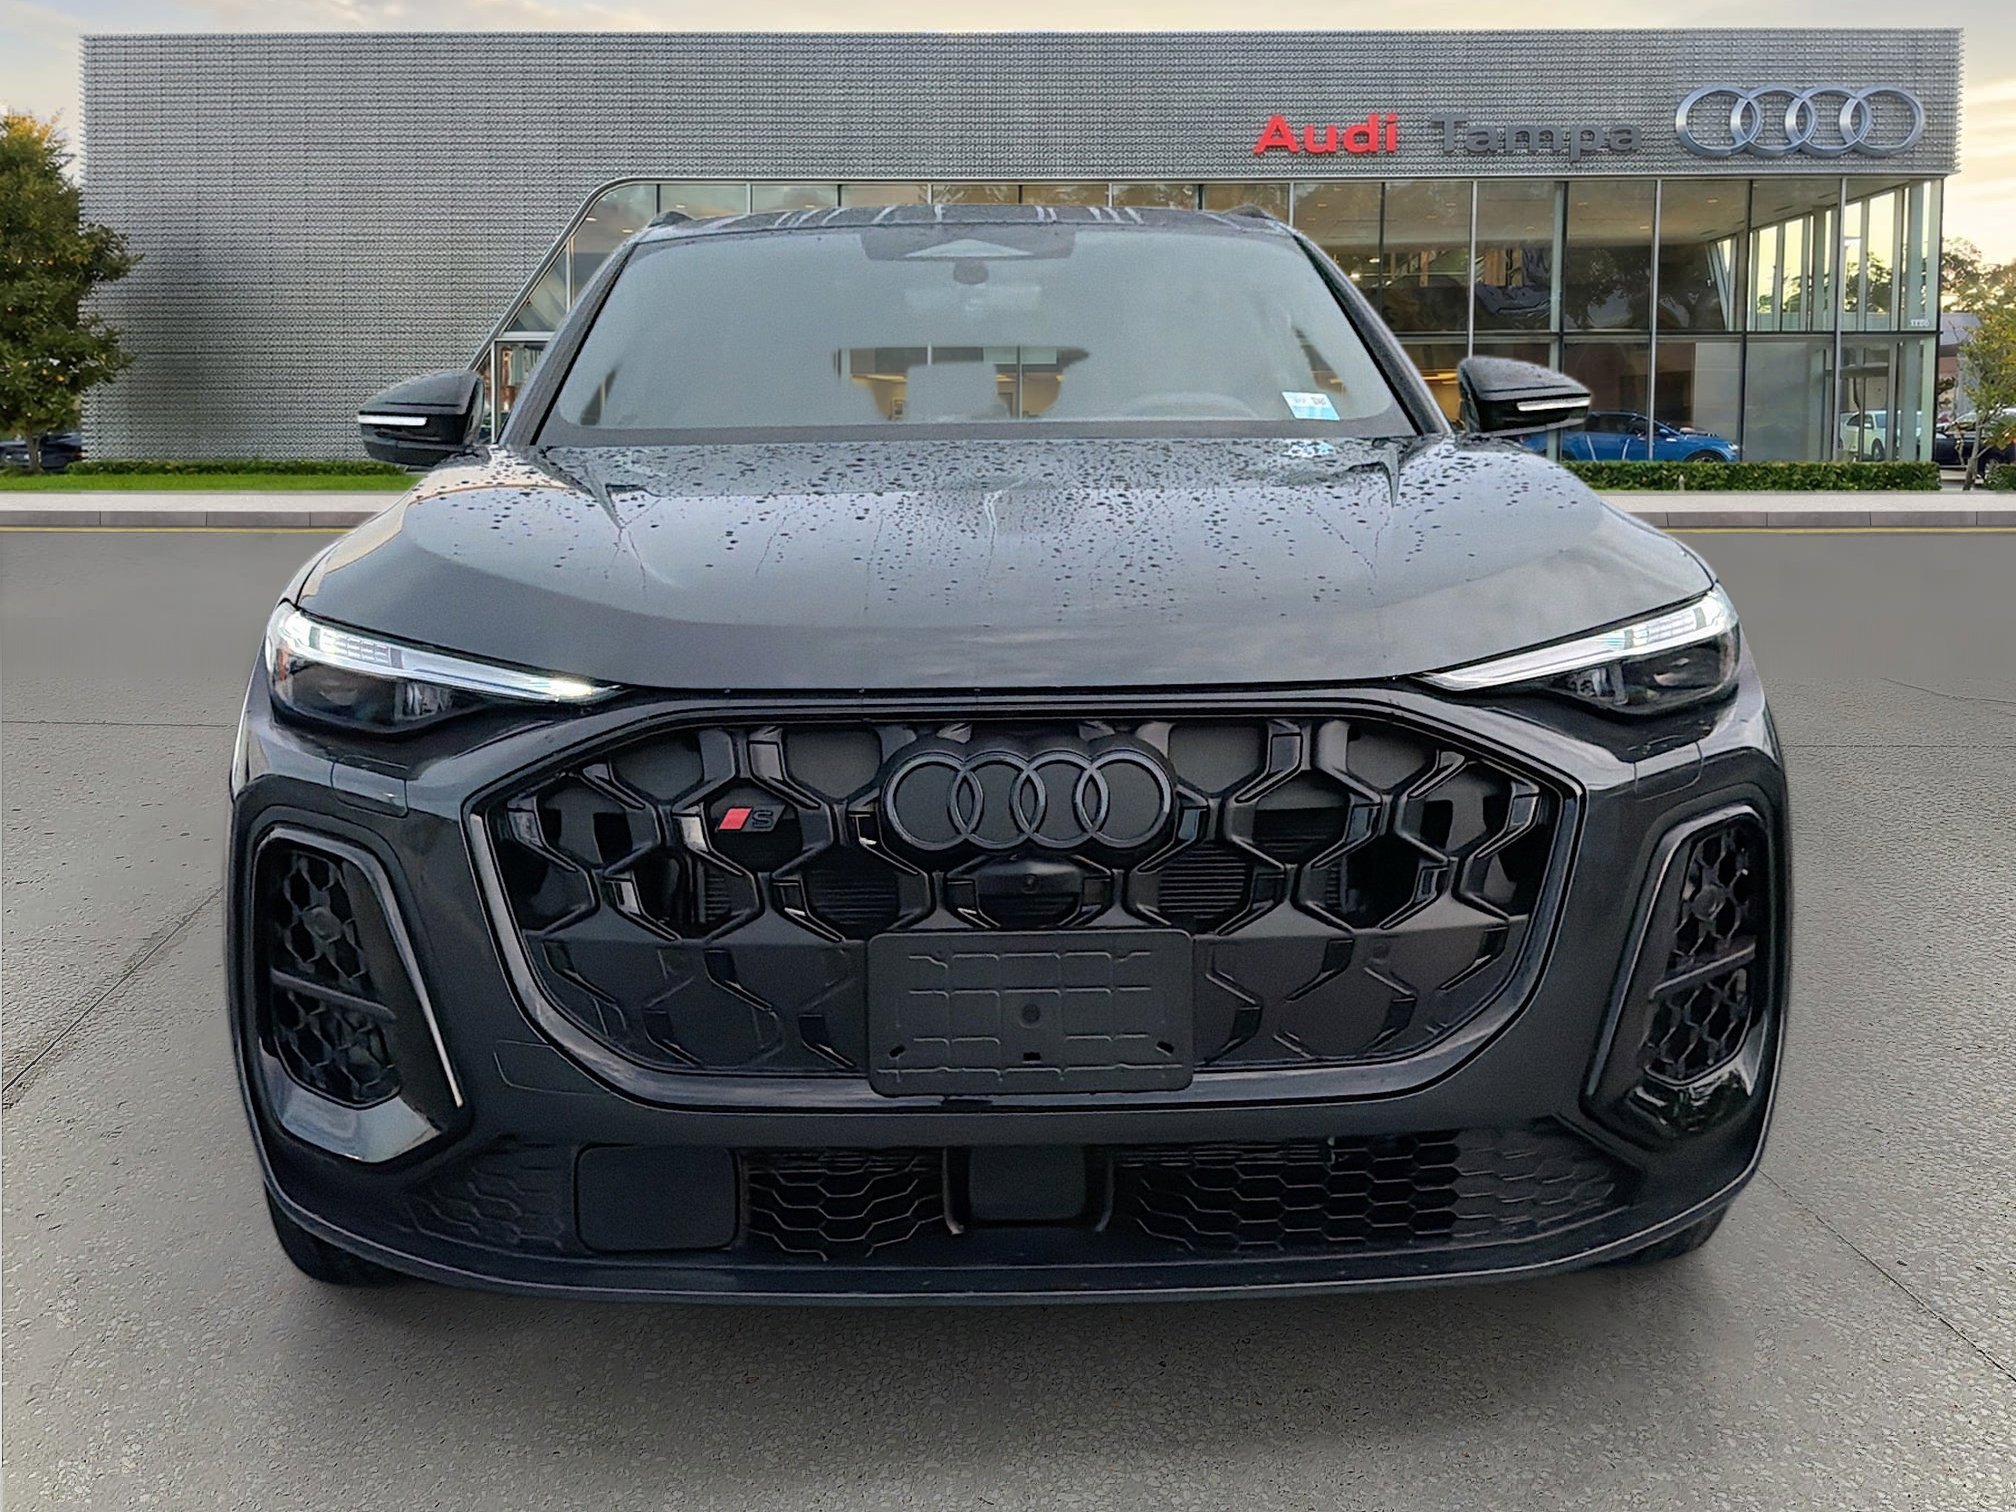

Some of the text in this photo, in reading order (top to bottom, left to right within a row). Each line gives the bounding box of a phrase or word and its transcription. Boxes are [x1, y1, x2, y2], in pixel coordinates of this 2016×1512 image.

[1253, 113, 1642, 163] Audi Tampa
[752, 809, 774, 829] S
